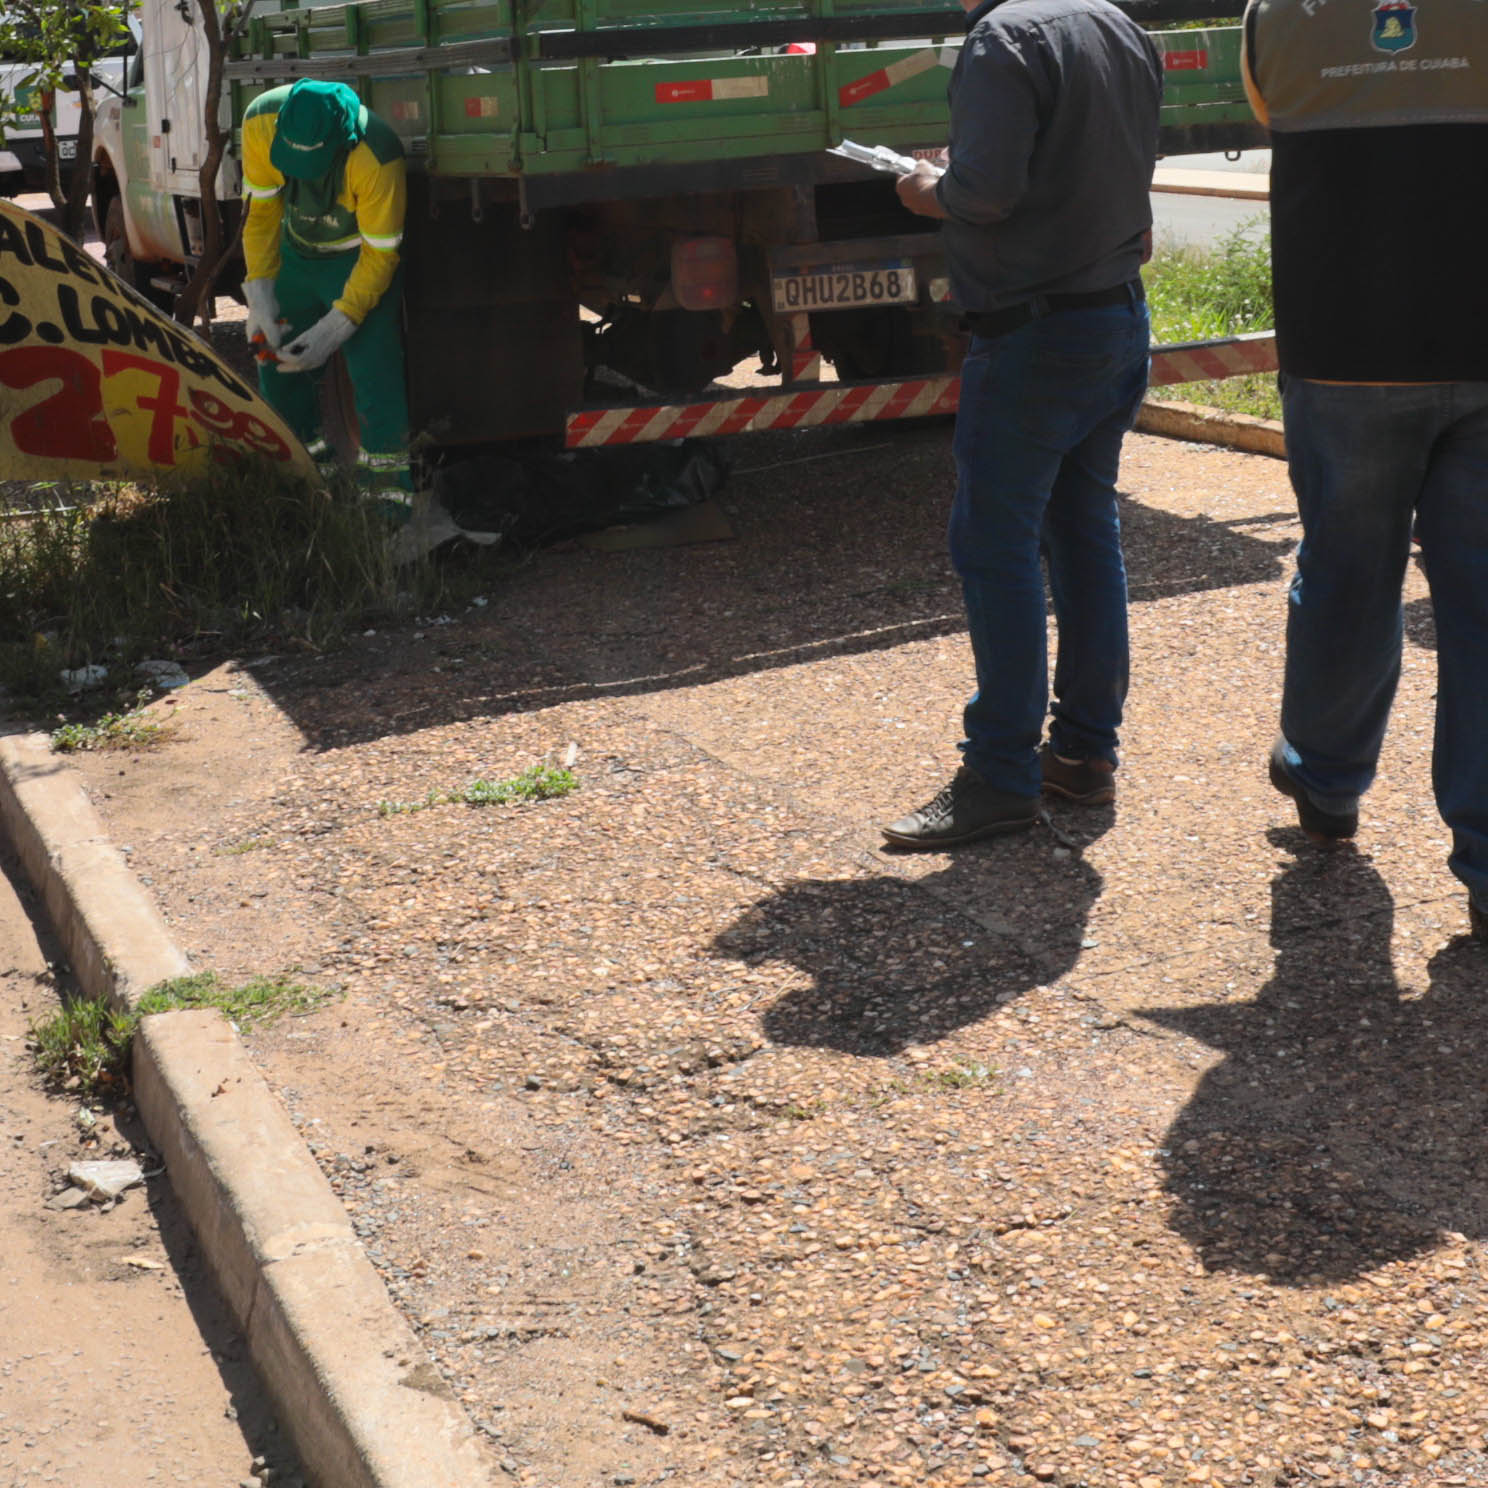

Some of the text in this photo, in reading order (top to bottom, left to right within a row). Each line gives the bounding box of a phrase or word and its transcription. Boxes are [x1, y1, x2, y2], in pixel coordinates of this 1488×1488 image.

[1320, 61, 1396, 79] PREFEITURA
[1399, 59, 1417, 72] DE
[785, 271, 902, 307] QHU2B68
